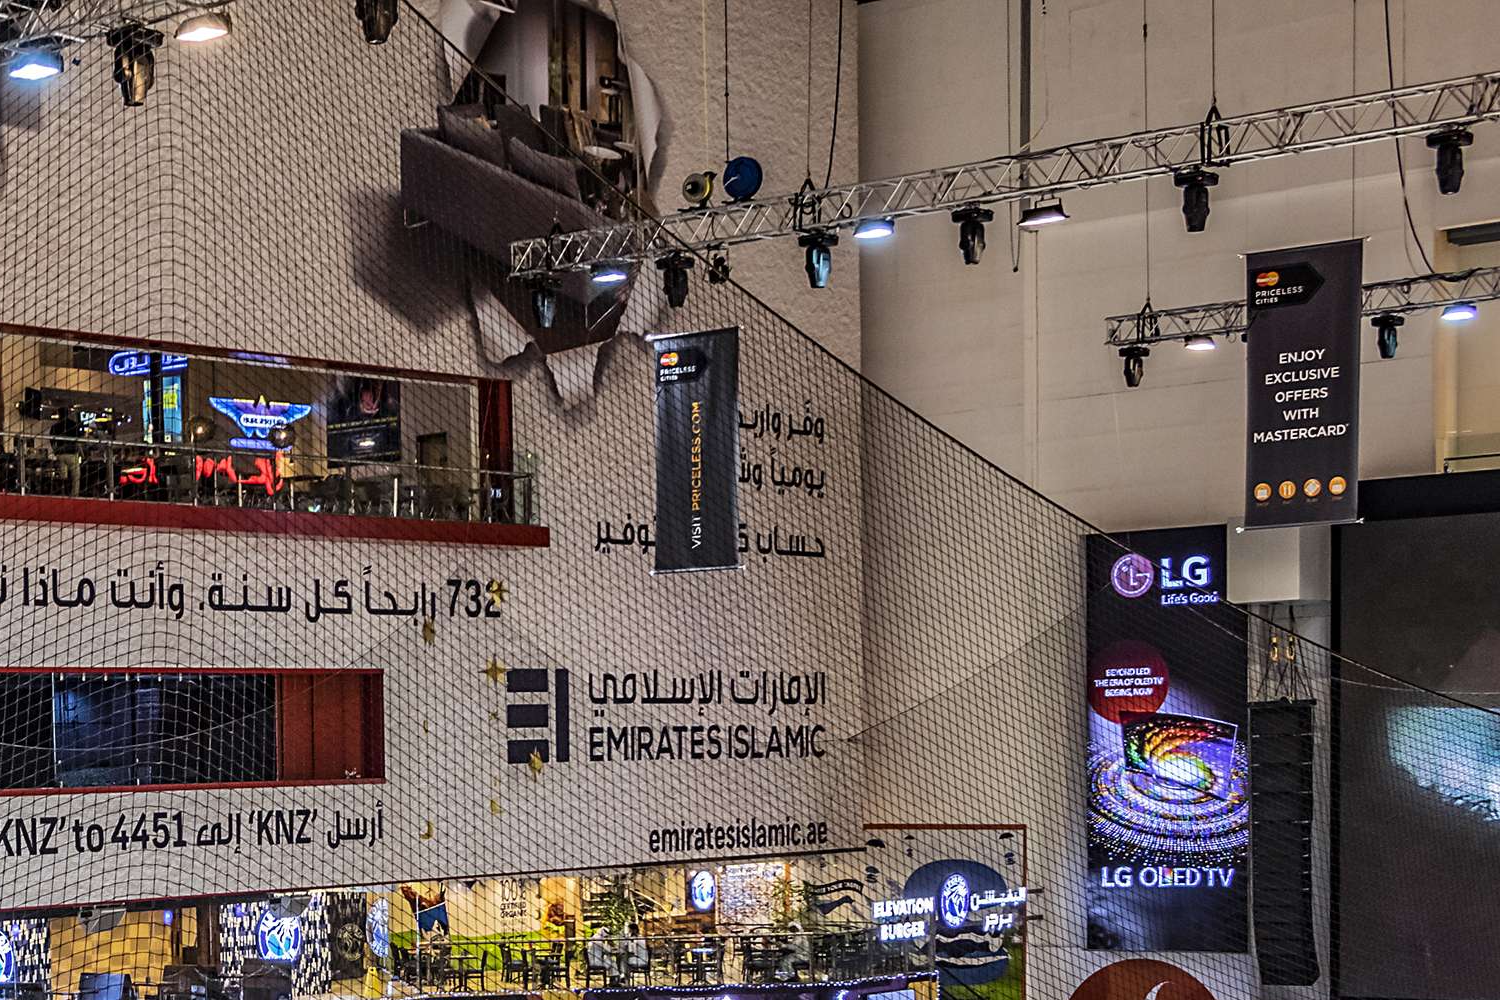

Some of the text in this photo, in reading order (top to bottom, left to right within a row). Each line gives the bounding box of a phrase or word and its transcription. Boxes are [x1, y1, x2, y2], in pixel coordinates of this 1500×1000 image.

[1255, 286, 1304, 298] PRICELESS
[1279, 349, 1326, 364] ENJOY
[1265, 366, 1340, 385] EXCLUSIVE
[1275, 387, 1329, 403] OFFERS
[1283, 407, 1319, 421] WITH
[1253, 424, 1348, 443] MASTERCARD
[691, 401, 703, 549] VISIT PRICELESS.COM
[22, 566, 96, 608] ماذا
[1161, 556, 1211, 588] LG
[304, 579, 351, 623] كل
[447, 578, 503, 619] 732
[1161, 591, 1218, 605] Life's Good
[589, 669, 826, 717] الإمارات الإسلامي
[589, 725, 826, 761] EMIRATES ISLAMIC
[73, 821, 104, 853] to
[111, 811, 186, 850] 4451
[248, 809, 318, 845] 'KNZ'
[326, 800, 383, 848] أرسل
[649, 818, 828, 853] emiratesislamic.ae
[1101, 865, 1235, 889] LG OLED TV
[873, 896, 934, 918] ELEVATION
[880, 920, 926, 941] BURGER
